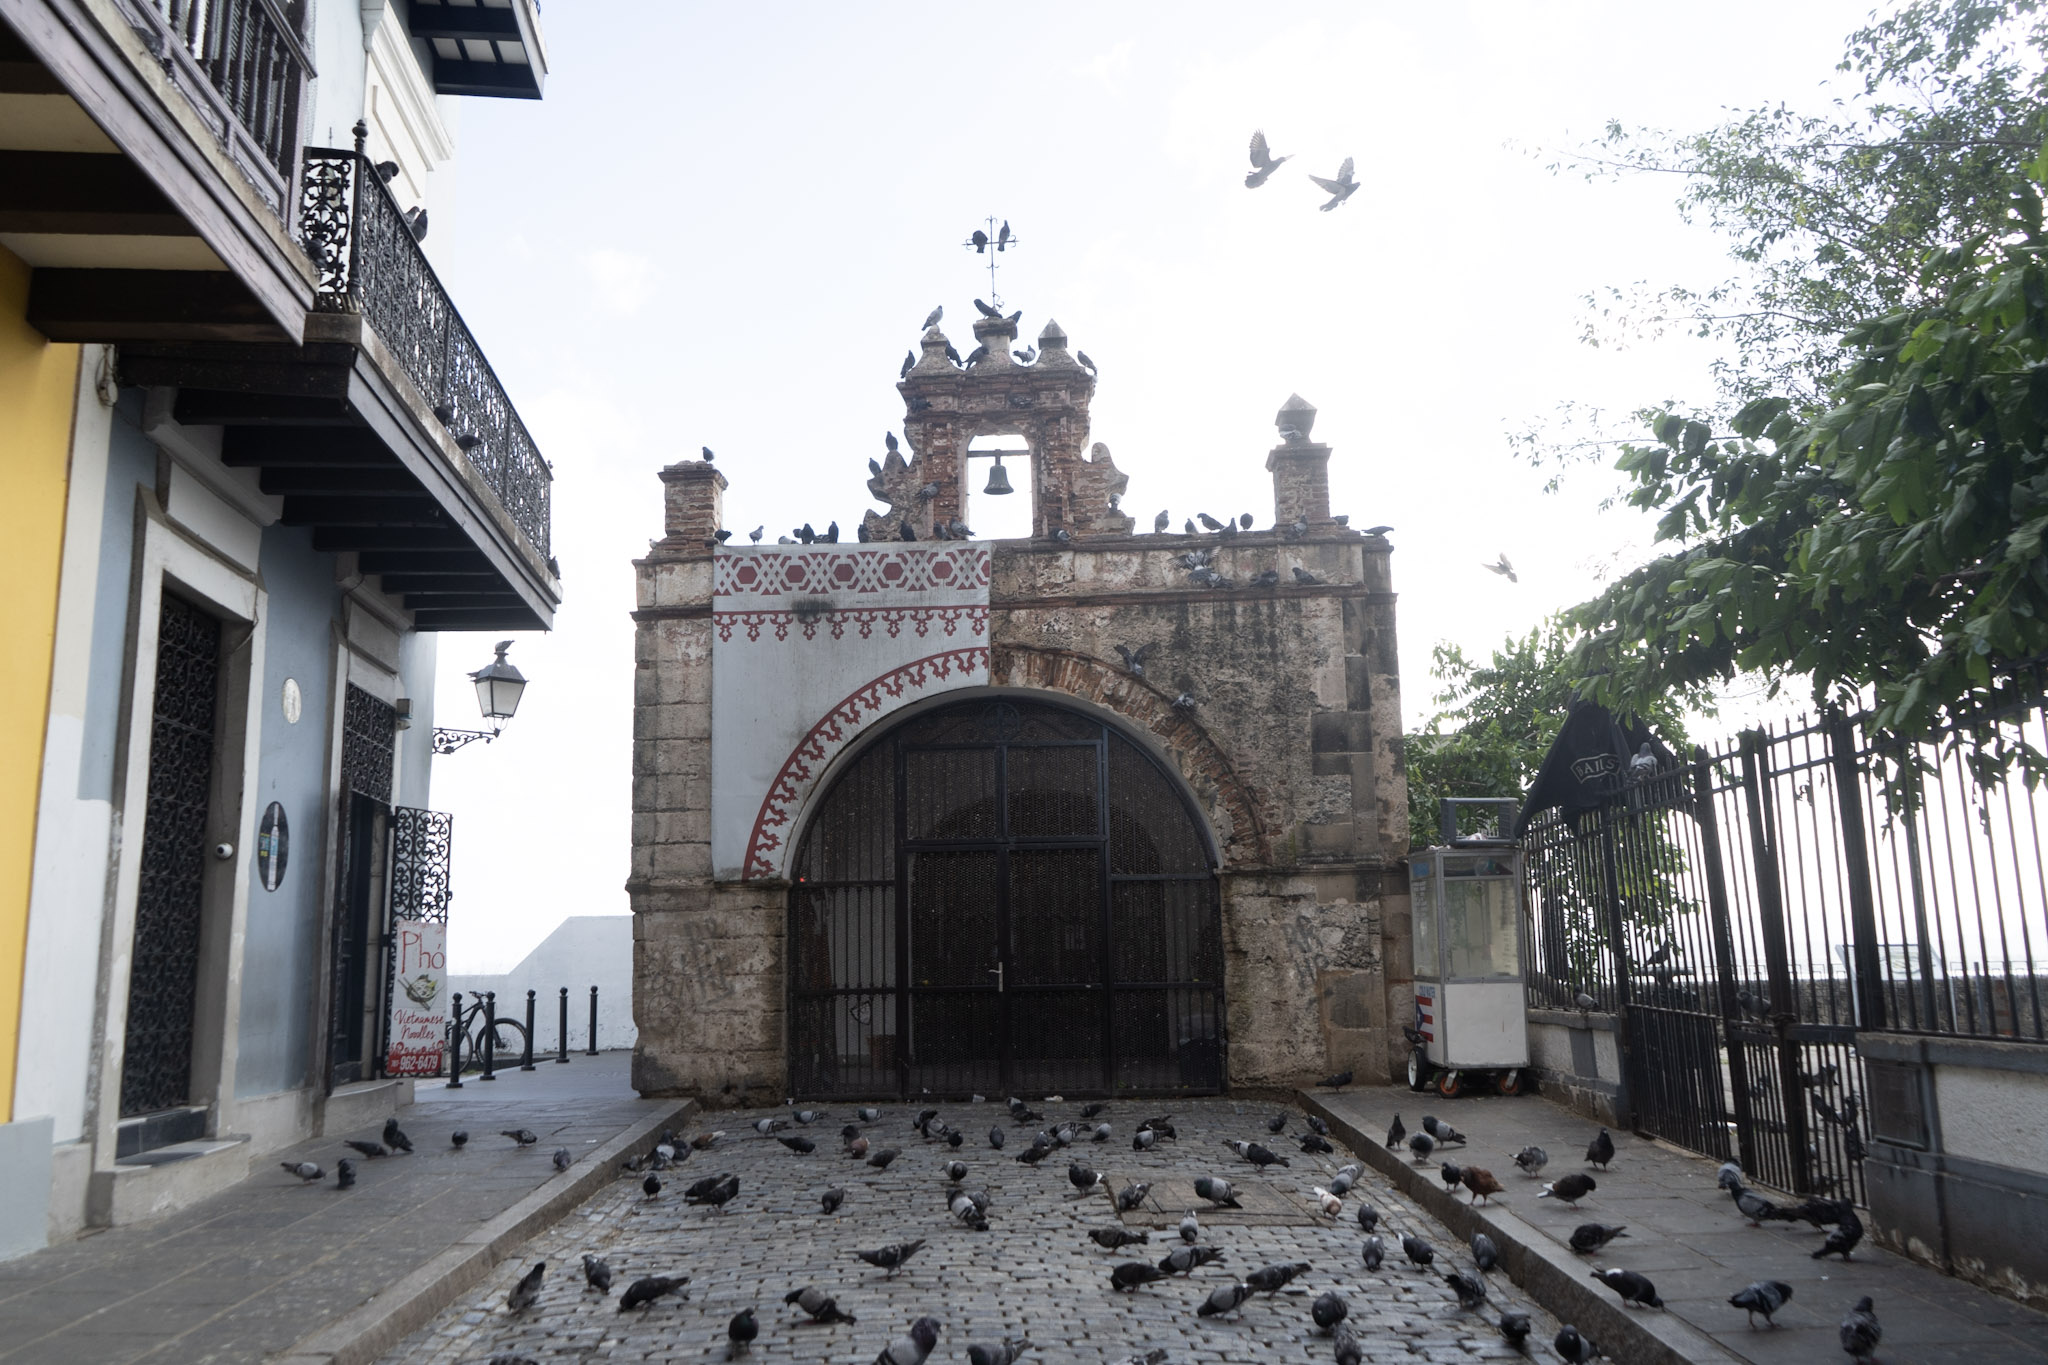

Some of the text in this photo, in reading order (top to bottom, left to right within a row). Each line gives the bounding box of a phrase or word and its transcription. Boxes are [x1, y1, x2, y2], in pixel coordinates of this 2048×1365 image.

[394, 1008, 445, 1025] Vietnamese
[402, 1025, 436, 1040] Noodles
[400, 1055, 439, 1071] 962-6479
